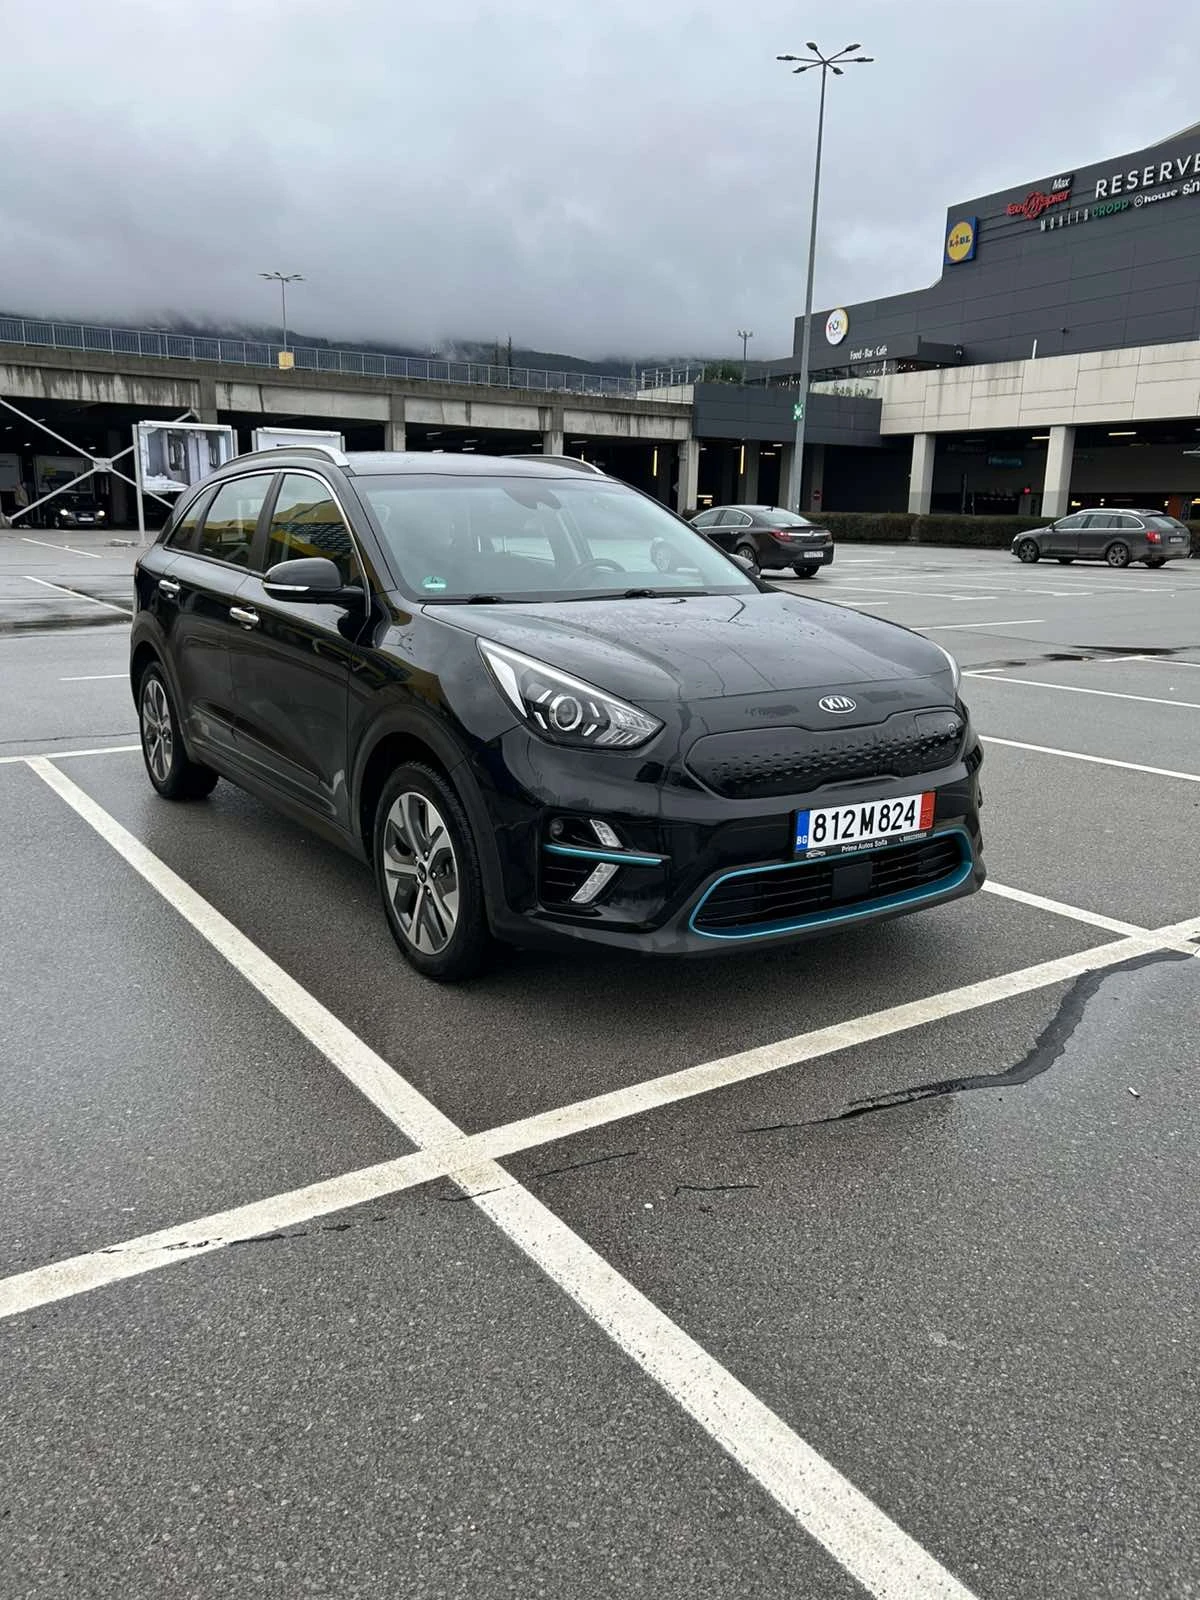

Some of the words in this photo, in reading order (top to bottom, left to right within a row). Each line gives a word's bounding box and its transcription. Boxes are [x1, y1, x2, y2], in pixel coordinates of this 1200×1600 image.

[1052, 177, 1071, 191] Max
[1144, 188, 1178, 204] house
[824, 696, 854, 710] KIA
[812, 799, 916, 843] 812M824
[796, 835, 807, 846] BG
[841, 845, 857, 853] Prime
[858, 842, 873, 851] Autos
[874, 839, 888, 848] Sofia
